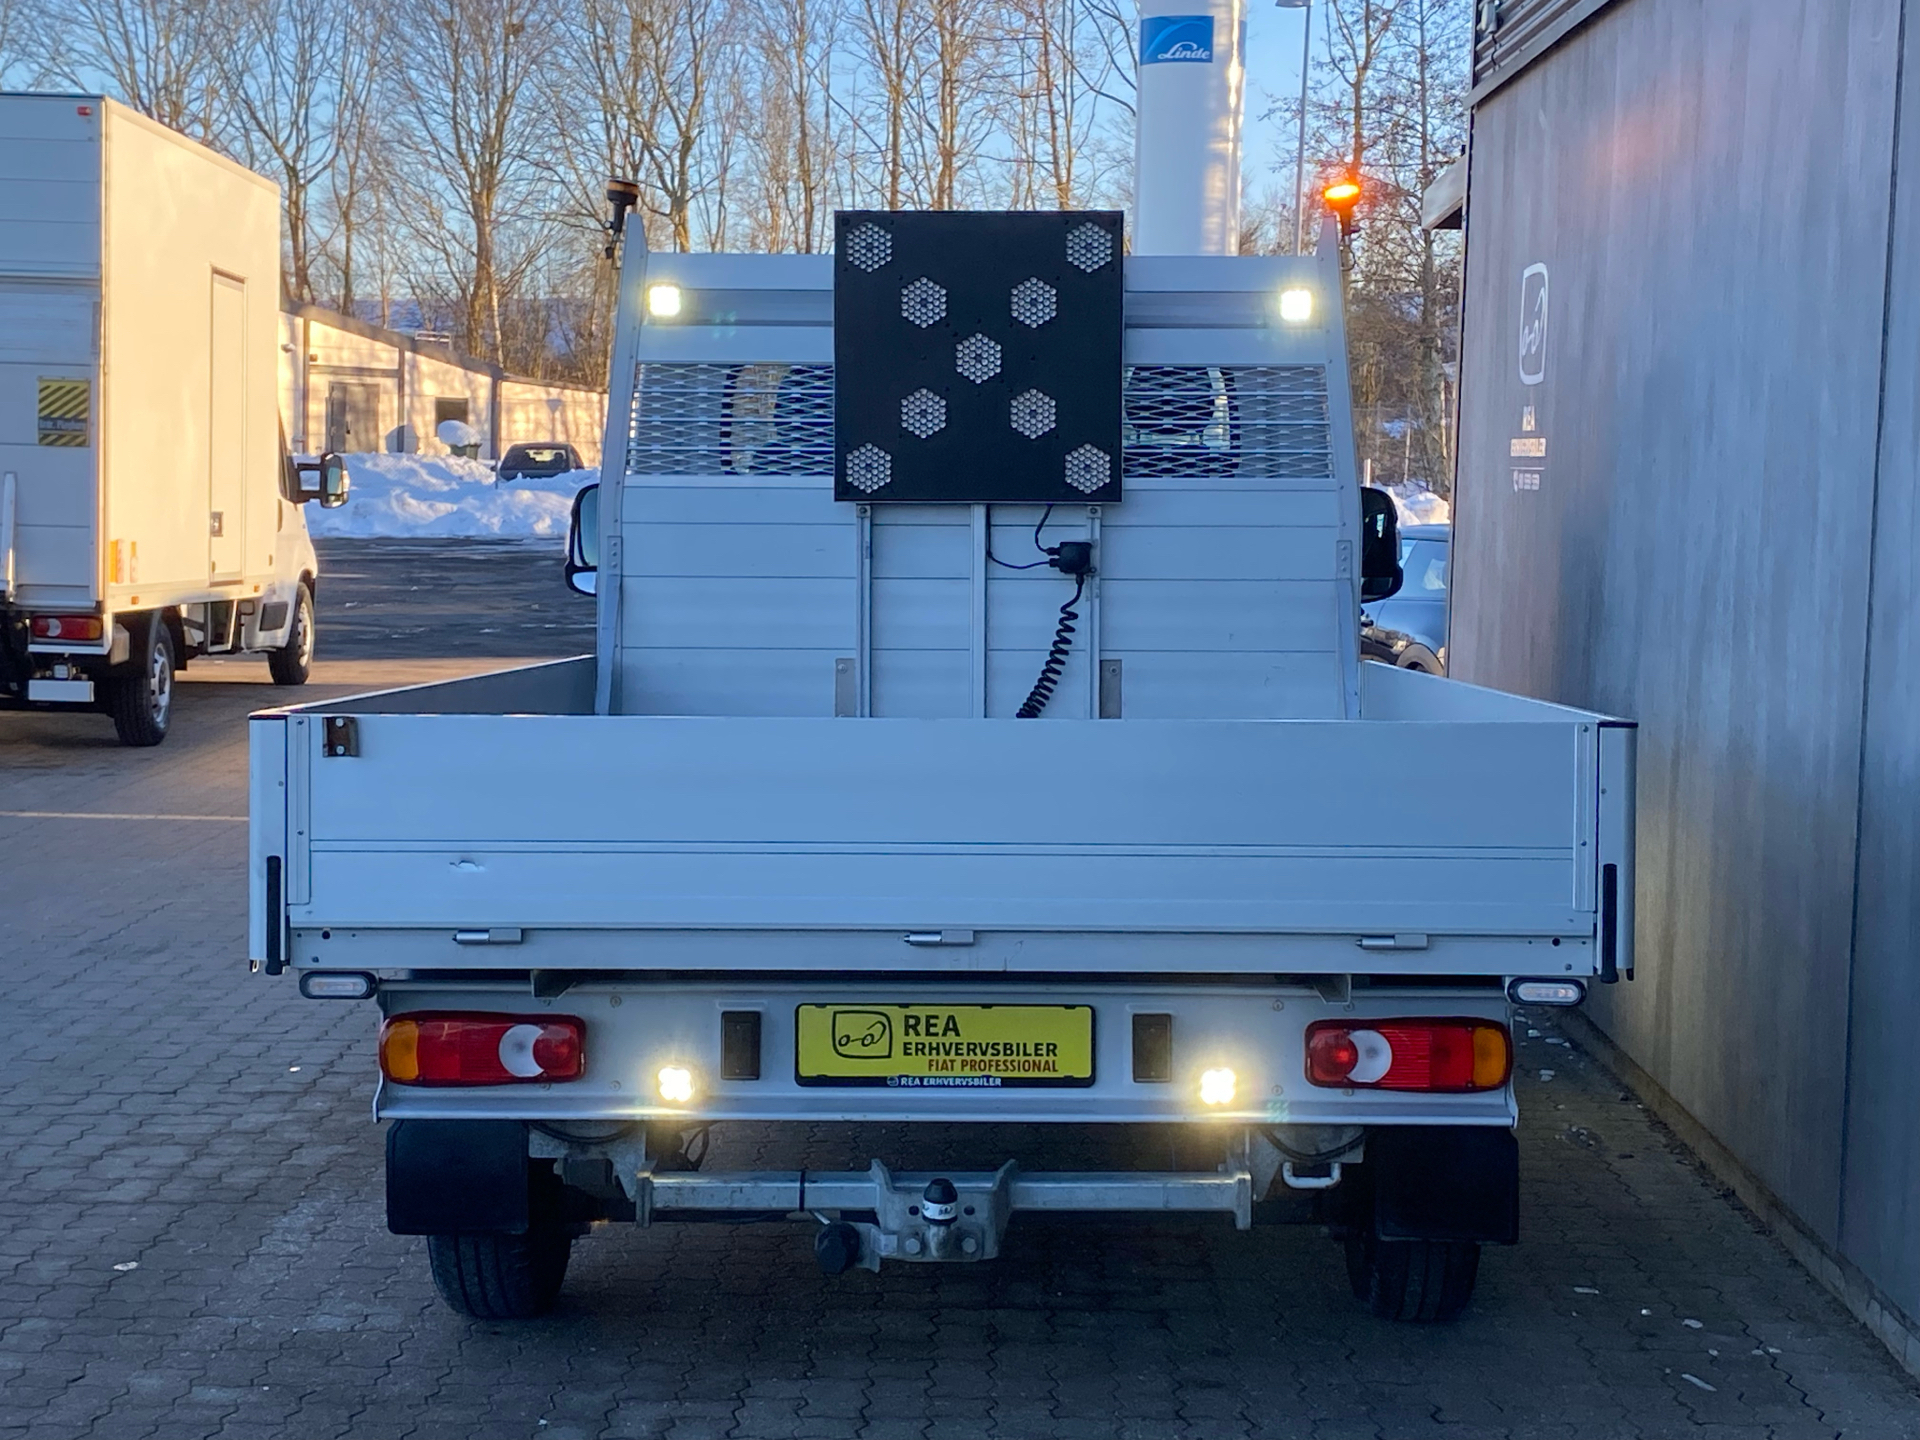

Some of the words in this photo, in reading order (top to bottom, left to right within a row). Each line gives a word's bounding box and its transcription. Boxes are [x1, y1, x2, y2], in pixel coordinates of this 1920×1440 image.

[1157, 41, 1211, 59] Linde
[904, 1014, 961, 1037] REA
[903, 1042, 1058, 1057] ERHVERVSBILER
[928, 1059, 956, 1072] FIAT
[960, 1059, 1059, 1073] PROFESSIONAL
[900, 1077, 921, 1086] REA
[923, 1077, 1002, 1087] ERHVERVSBILER
